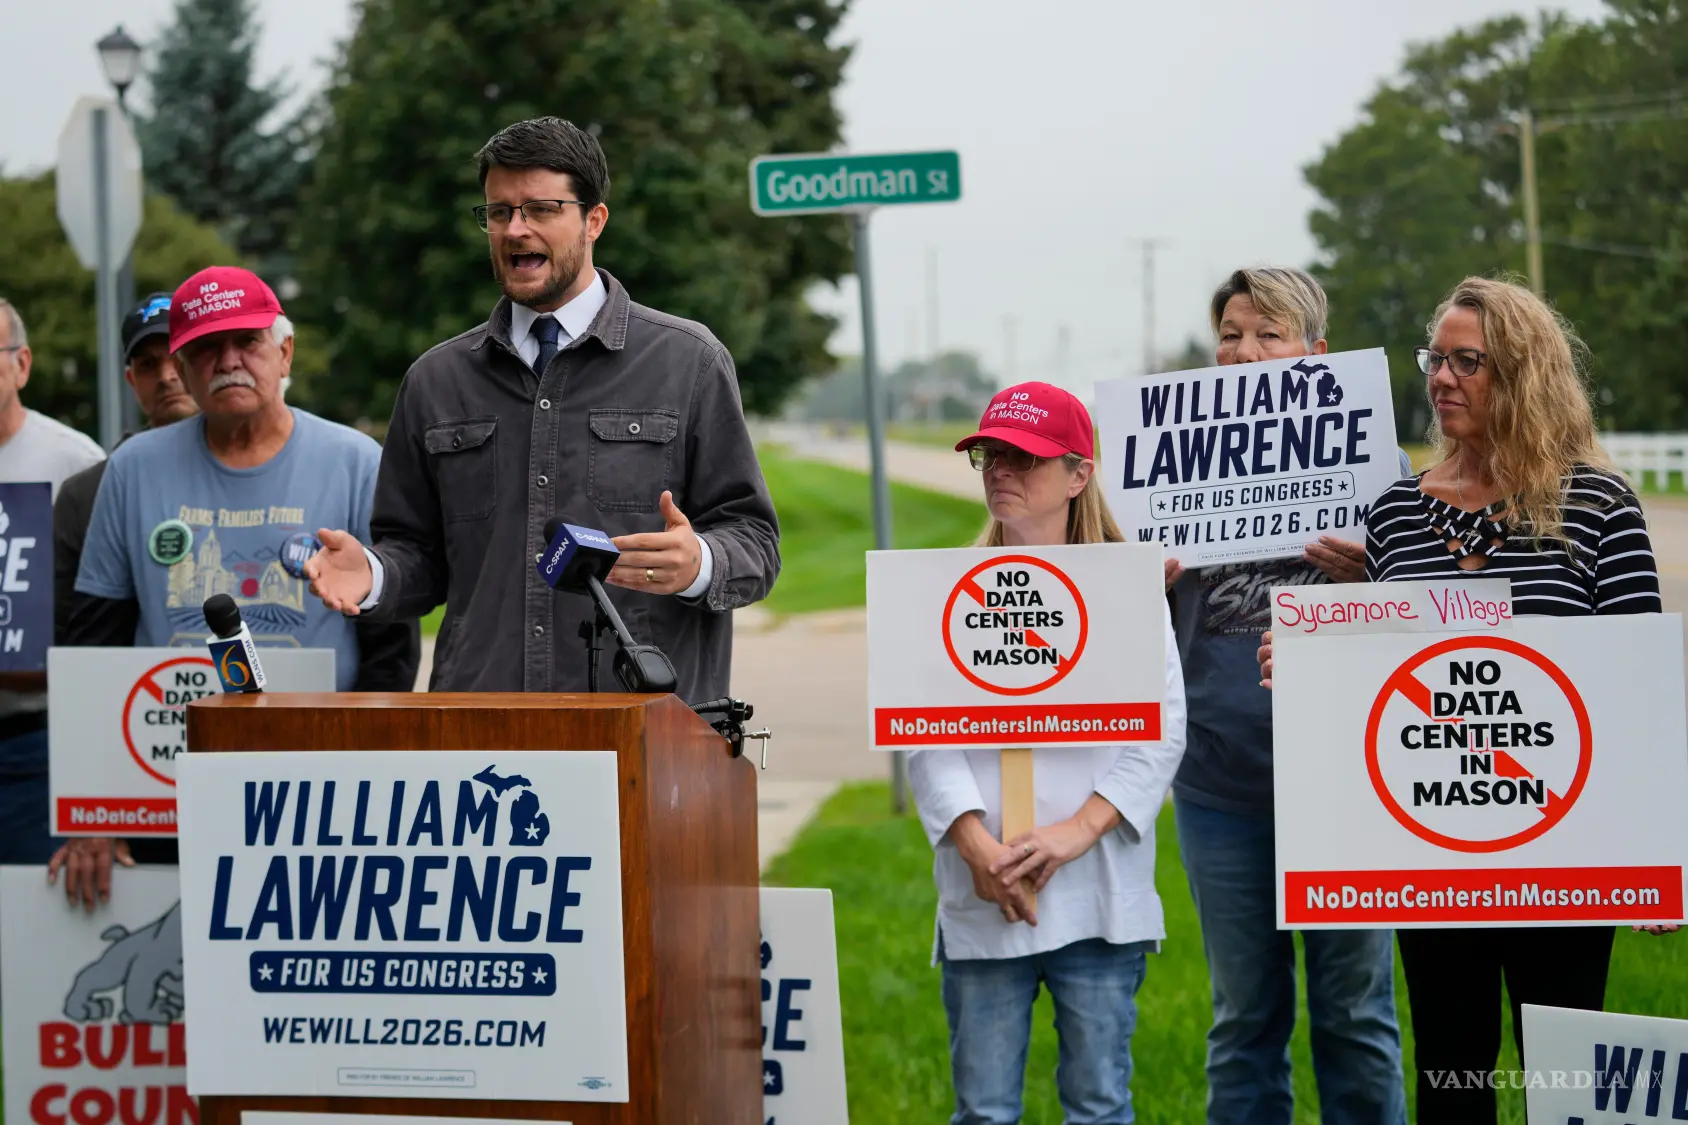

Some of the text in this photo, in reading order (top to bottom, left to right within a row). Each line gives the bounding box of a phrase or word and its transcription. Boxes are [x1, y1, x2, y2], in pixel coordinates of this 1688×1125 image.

[766, 165, 949, 203] Goodman St
[182, 289, 245, 312] Data Centers
[200, 281, 219, 294] NO
[198, 298, 241, 316] MASON
[1009, 400, 1049, 418] Centers
[1011, 392, 1029, 400] NO
[1140, 370, 1309, 428] WILLIAM
[998, 410, 1039, 425] MASON
[1122, 408, 1373, 490] LAWRENCE
[1172, 478, 1334, 513] FOR US CONGRESS
[1138, 504, 1370, 548] WEWILL2026.COM
[996, 570, 1030, 588] NO
[986, 590, 1044, 608] DATA
[1276, 588, 1512, 633] Sycamore Village
[965, 610, 1064, 629] CENTERS
[1003, 632, 1024, 646] IN
[221, 644, 250, 687] 6
[973, 648, 1058, 667] MASON
[175, 671, 207, 687] NO
[1449, 659, 1501, 686] NO
[1433, 690, 1523, 717] DATA
[890, 714, 1145, 736] NoDataCentersInMason.com
[1400, 721, 1555, 749] CENTERS
[1460, 754, 1491, 775] IN
[1413, 779, 1544, 807] MASON
[244, 780, 500, 847] WILLIAM
[208, 855, 593, 944] LAWRENCE
[1306, 882, 1660, 910] NoDataCentersInMason.com
[280, 958, 525, 989] FOR US CONGRESS
[263, 1017, 547, 1048] WEWILL2026.COM
